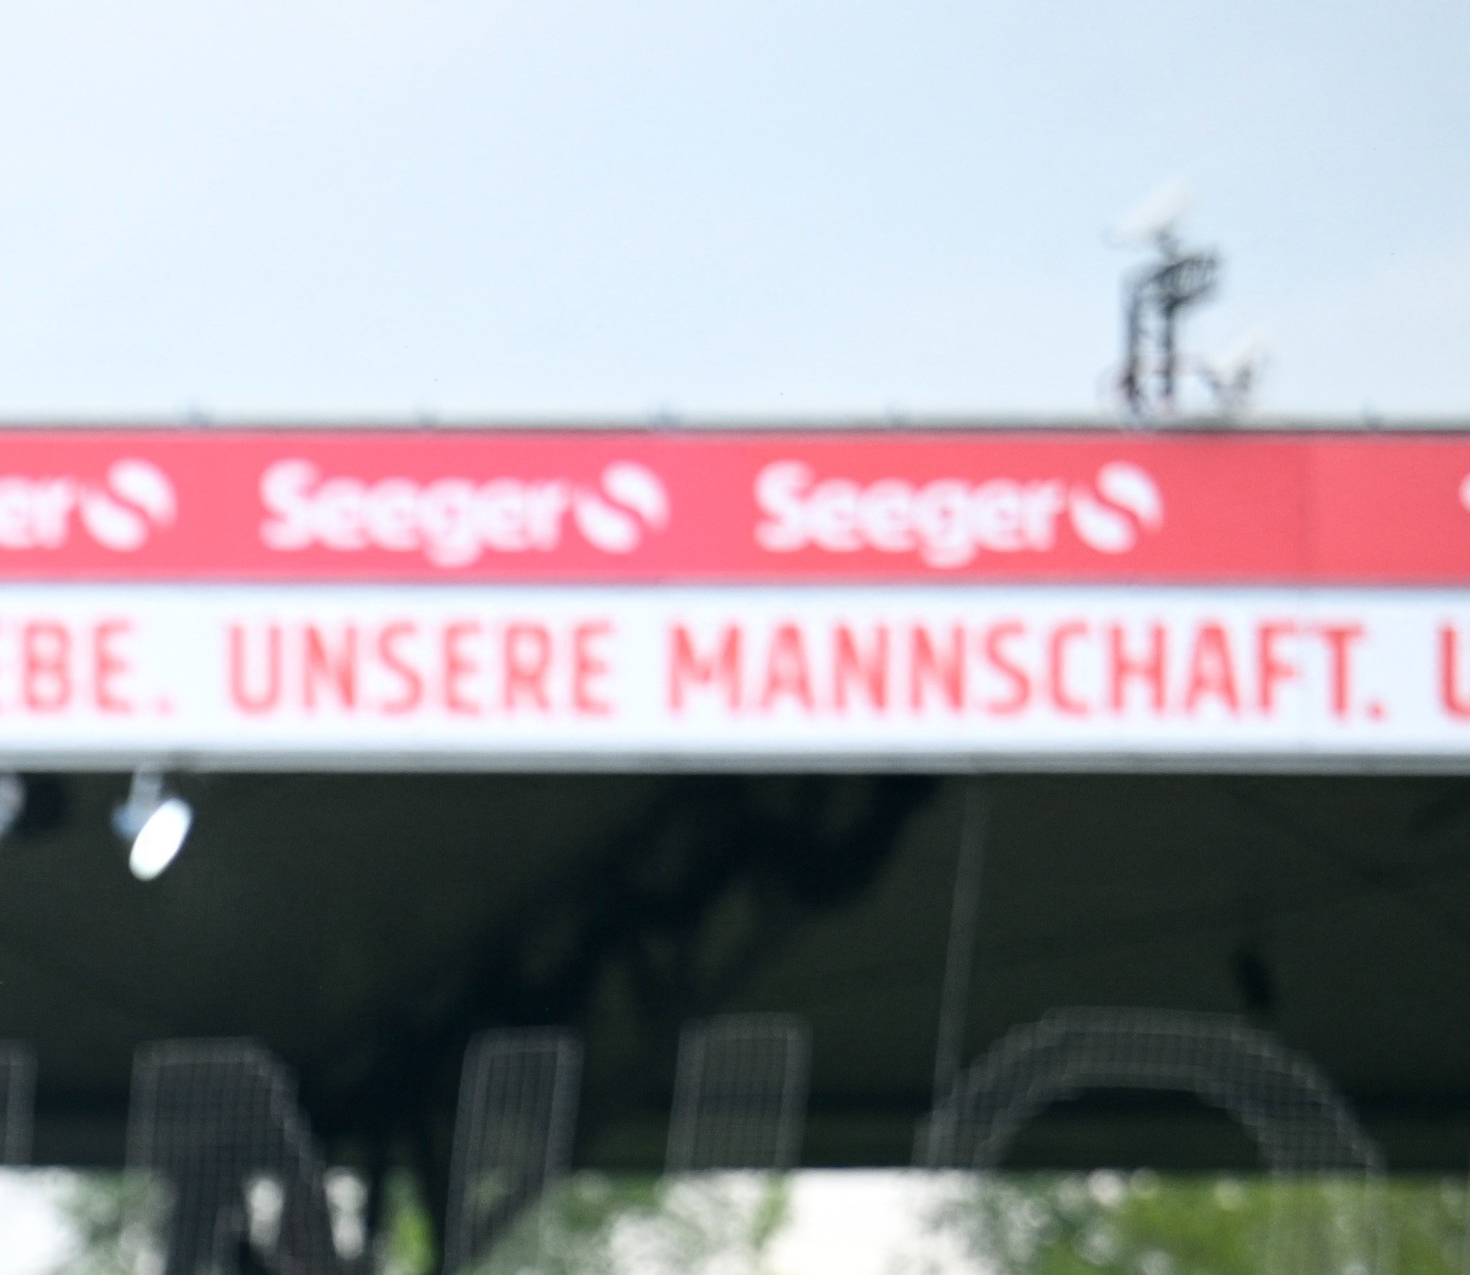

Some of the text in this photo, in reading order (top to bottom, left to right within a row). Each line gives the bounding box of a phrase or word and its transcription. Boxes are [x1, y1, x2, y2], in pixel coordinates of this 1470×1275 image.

[259, 458, 575, 569] Seeger
[754, 460, 1066, 569] Seeger
[228, 619, 616, 716] UNSERE
[668, 619, 1385, 718] MANNSCHAFT.
